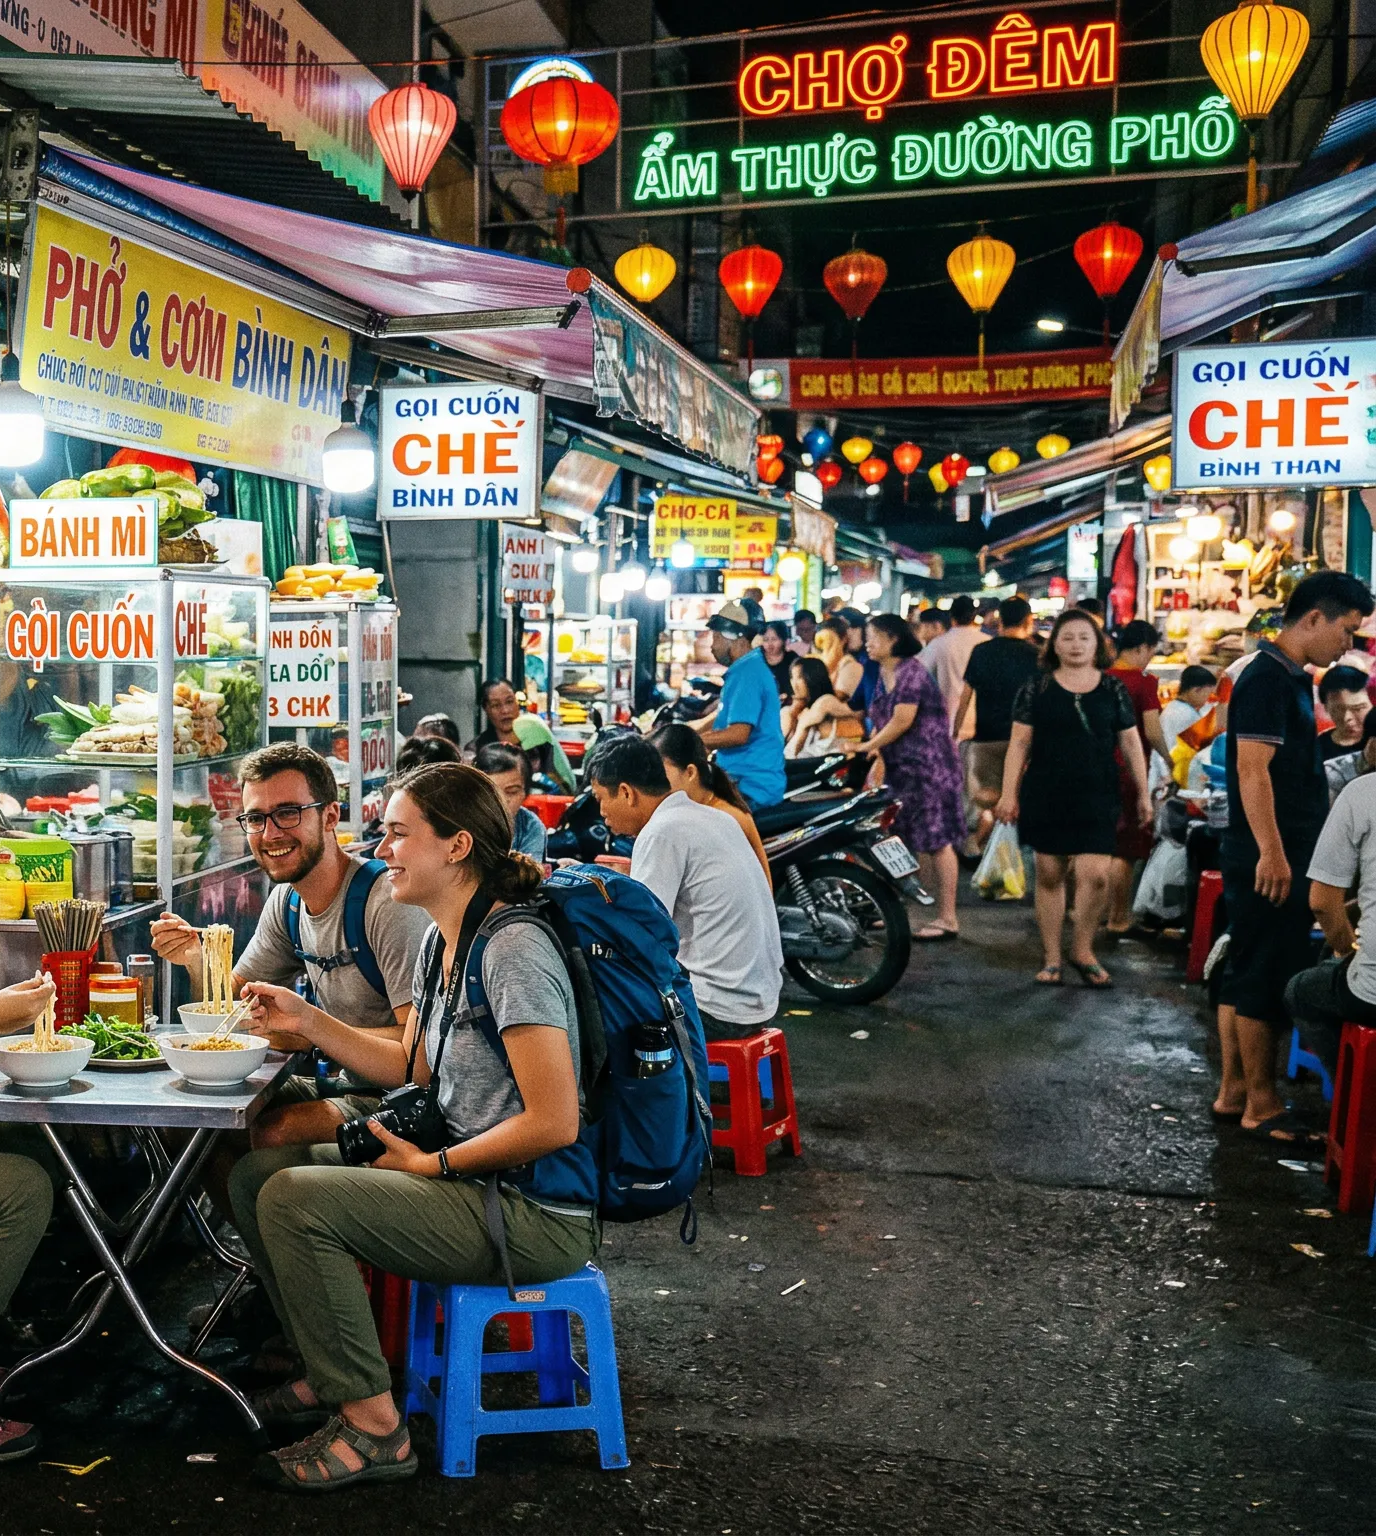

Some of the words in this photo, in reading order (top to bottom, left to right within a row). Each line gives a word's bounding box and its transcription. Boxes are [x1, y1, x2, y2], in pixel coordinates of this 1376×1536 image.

[738, 35, 908, 120] CHỢ
[926, 14, 1117, 100] ĐÊM
[635, 133, 718, 202] ẨM
[730, 132, 878, 198] THỰC
[891, 115, 1094, 181] ĐƯỜNG
[42, 236, 129, 351] PHỞ
[128, 289, 152, 361] &
[159, 292, 228, 384] CƠM
[231, 304, 295, 404] BÌNH
[297, 335, 348, 419] DÂN
[1192, 359, 1247, 387] GỌI
[1258, 346, 1351, 381] CUỐN
[395, 398, 438, 422] GỌI
[448, 388, 520, 416] CUỐN
[1199, 454, 1261, 478] BÌNH
[1271, 458, 1342, 476] THAN
[392, 483, 454, 508] BÌNH
[464, 482, 519, 507] DÂN
[19, 506, 101, 558] BÁNH
[111, 504, 147, 557] MÌ
[68, 593, 154, 659] CUỐN
